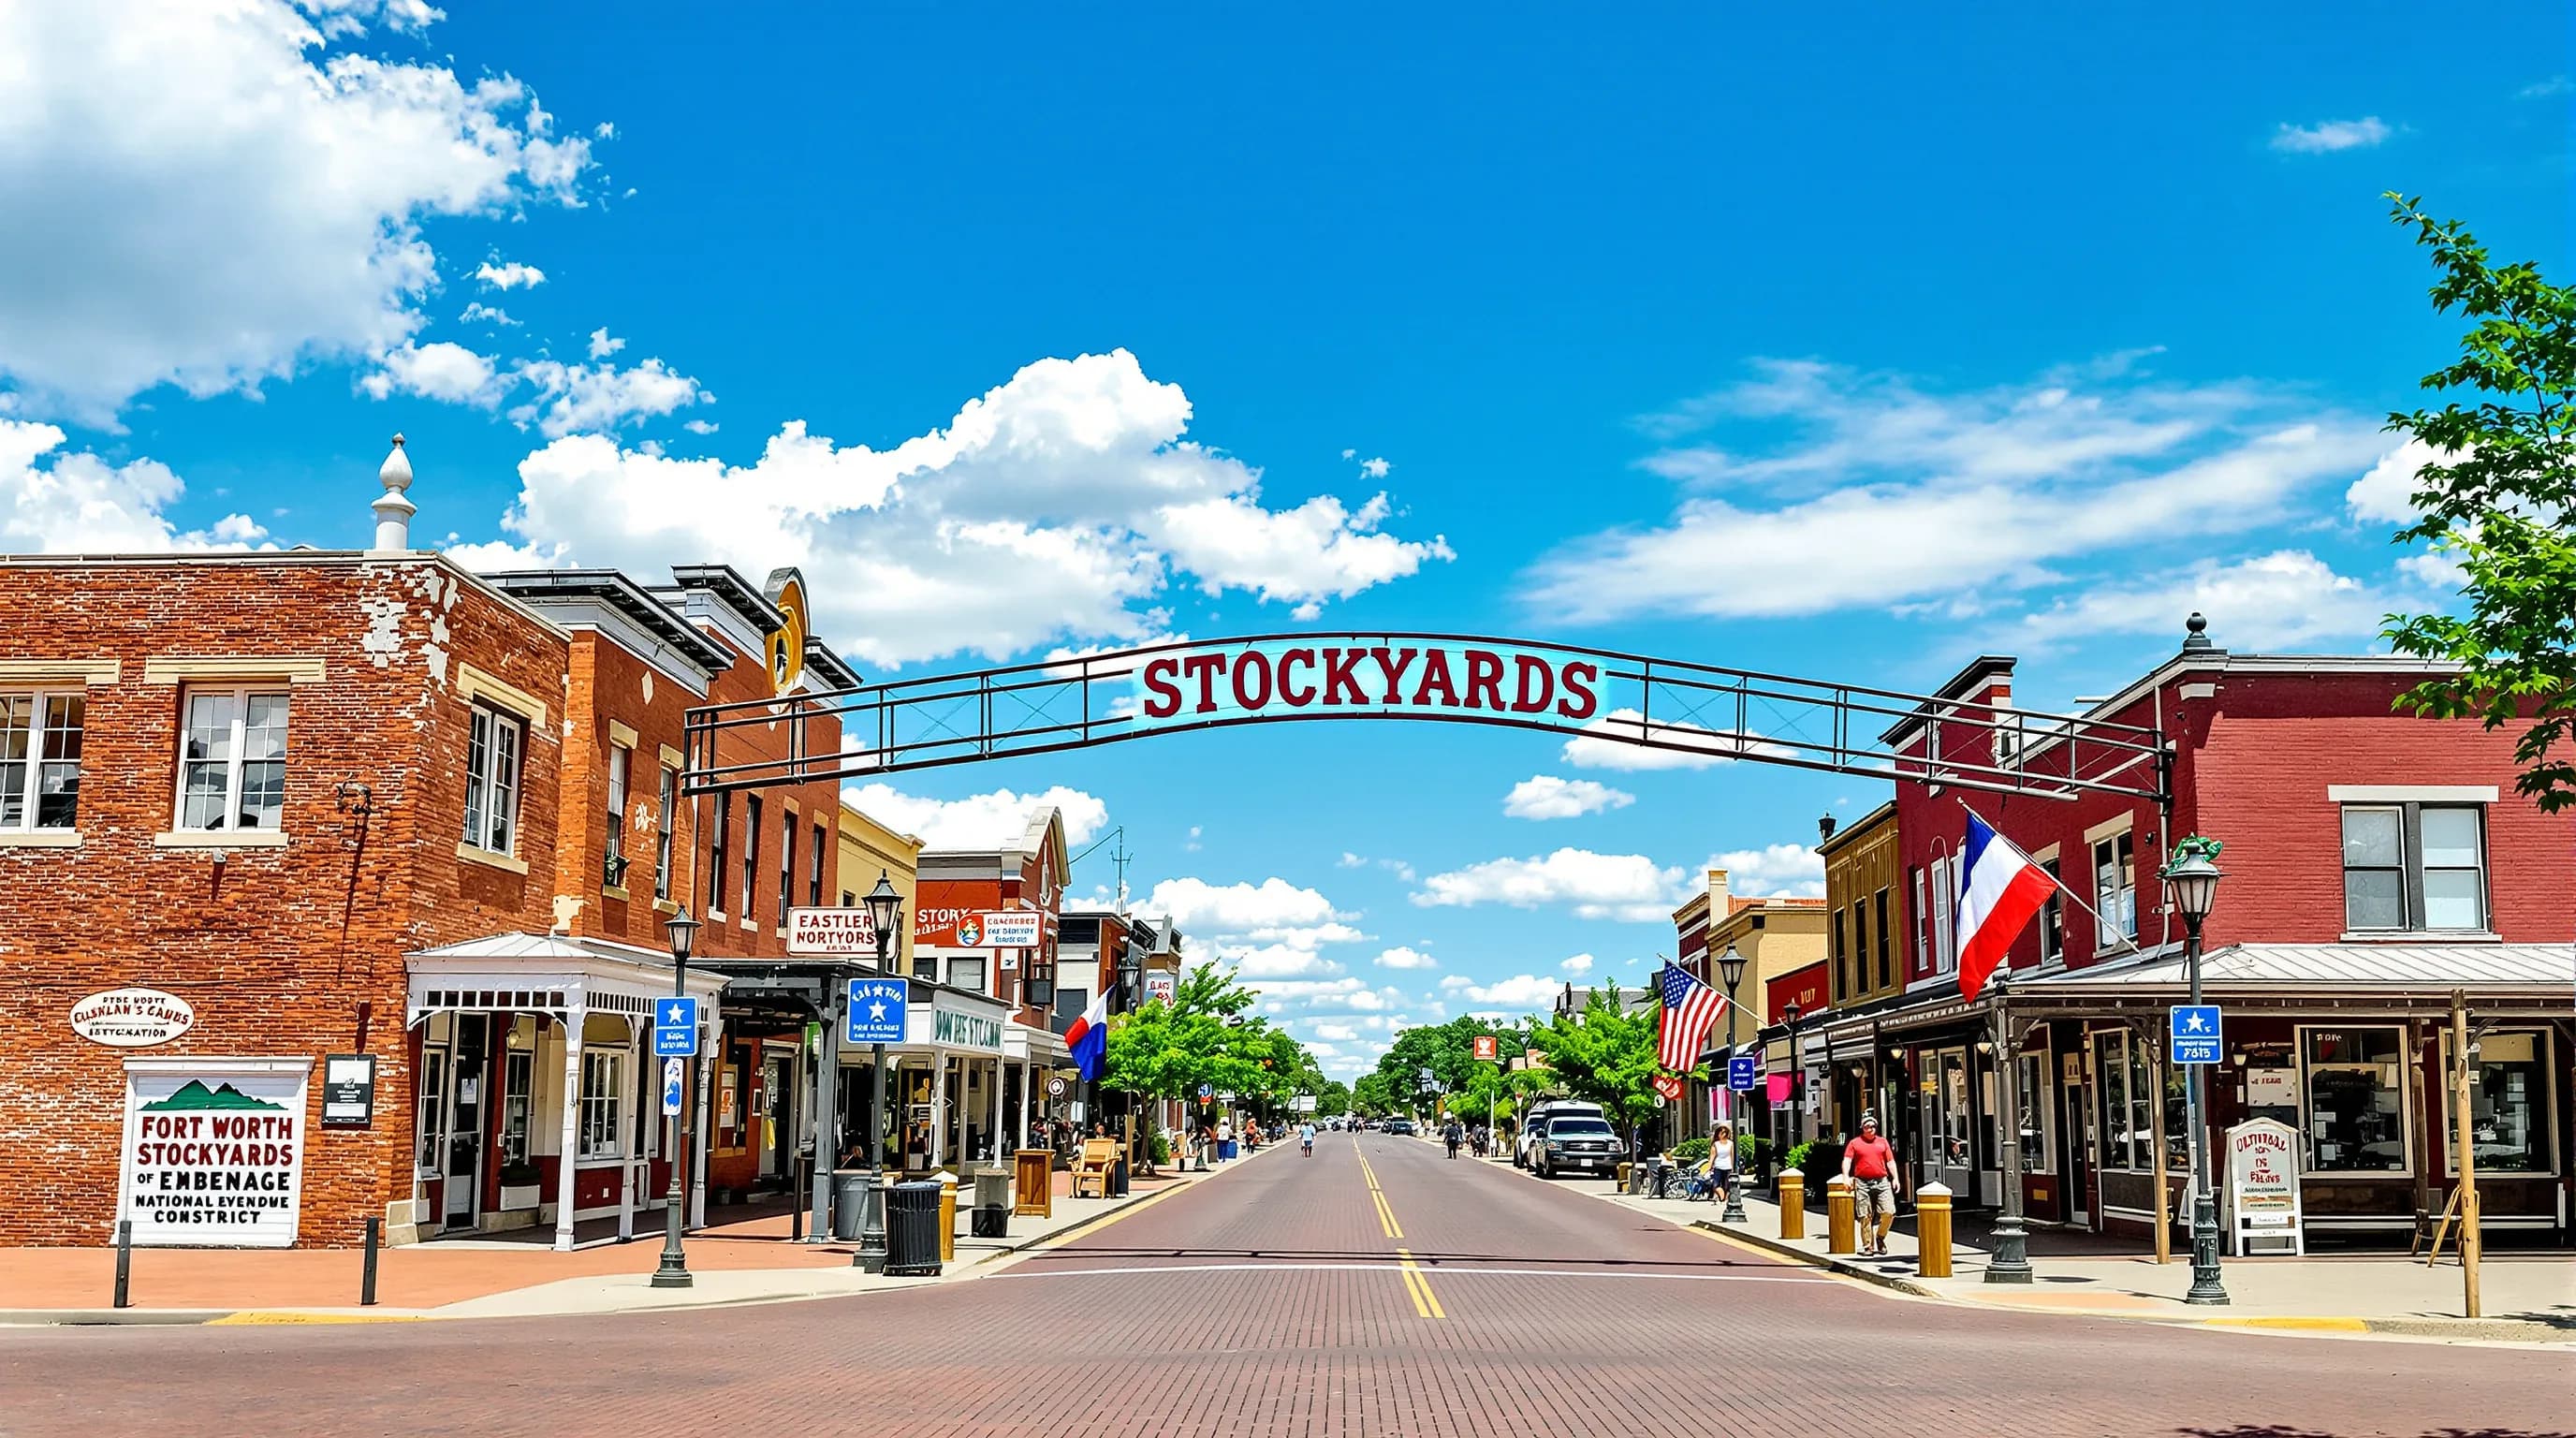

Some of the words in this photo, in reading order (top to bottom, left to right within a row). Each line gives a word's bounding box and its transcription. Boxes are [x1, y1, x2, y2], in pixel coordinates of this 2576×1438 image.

[1144, 647, 1597, 719] STOCKYARDS
[799, 915, 873, 930] EASTLER
[797, 931, 875, 945] NORTYORS
[141, 1116, 203, 1139] FORT
[212, 1116, 293, 1139] WORTH
[138, 1143, 293, 1167] STOCKYARDS
[137, 1173, 154, 1184] OF
[136, 1195, 213, 1208] NATIONAL
[154, 1210, 261, 1225] CONSTRICT
